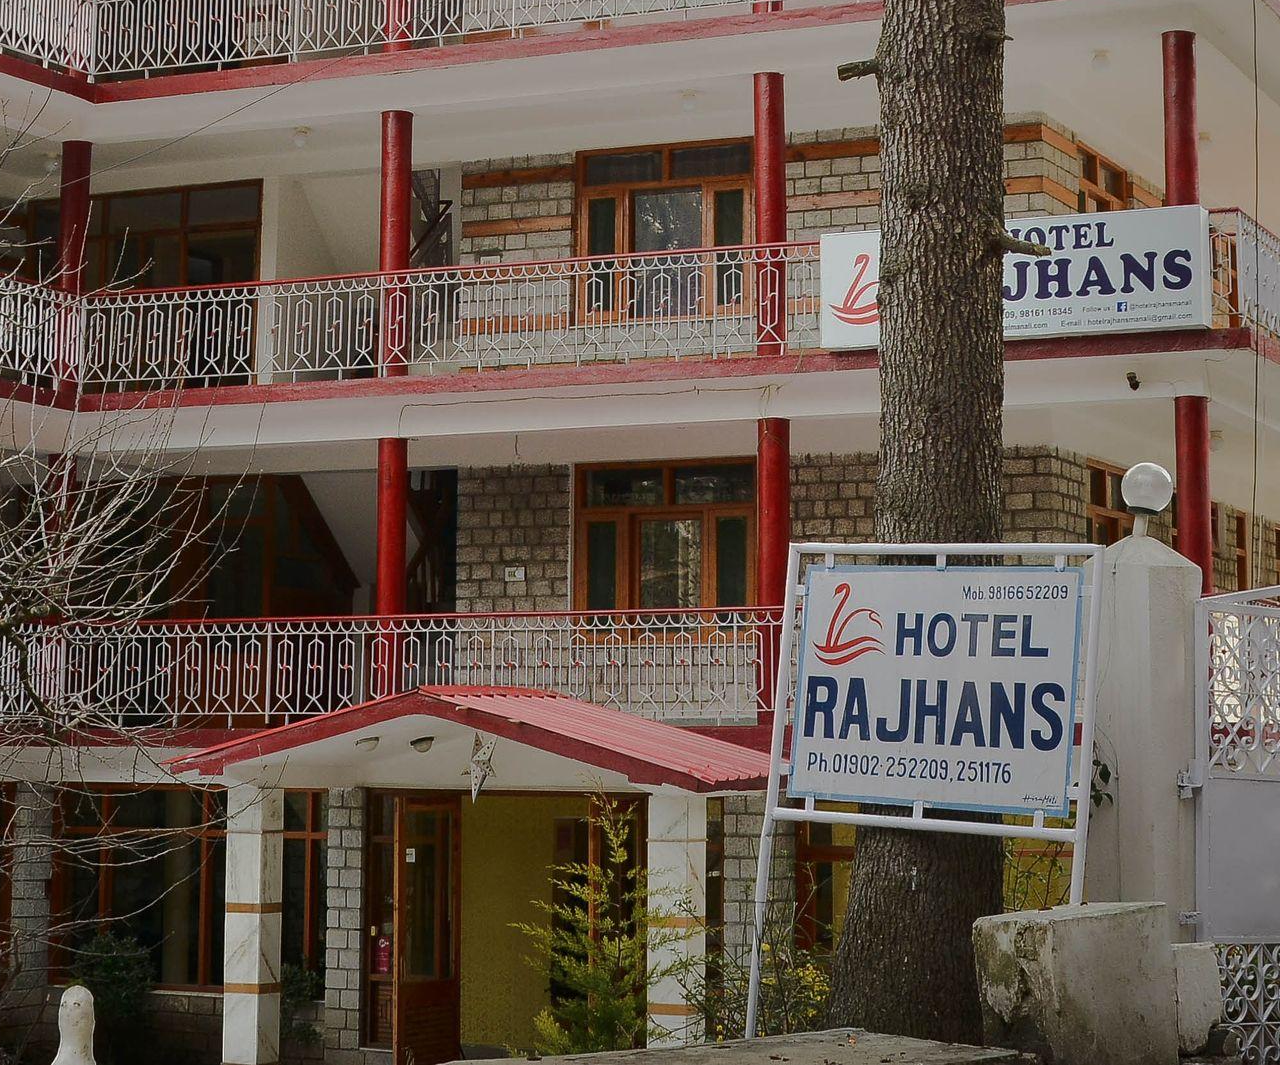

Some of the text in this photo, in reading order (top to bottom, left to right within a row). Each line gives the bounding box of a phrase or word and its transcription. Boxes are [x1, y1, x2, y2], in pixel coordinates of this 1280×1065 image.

[1019, 309, 1044, 318] 98161
[1048, 307, 1073, 316] 18345
[895, 612, 1049, 658] HOTEL
[803, 675, 1067, 752] RAJHANS
